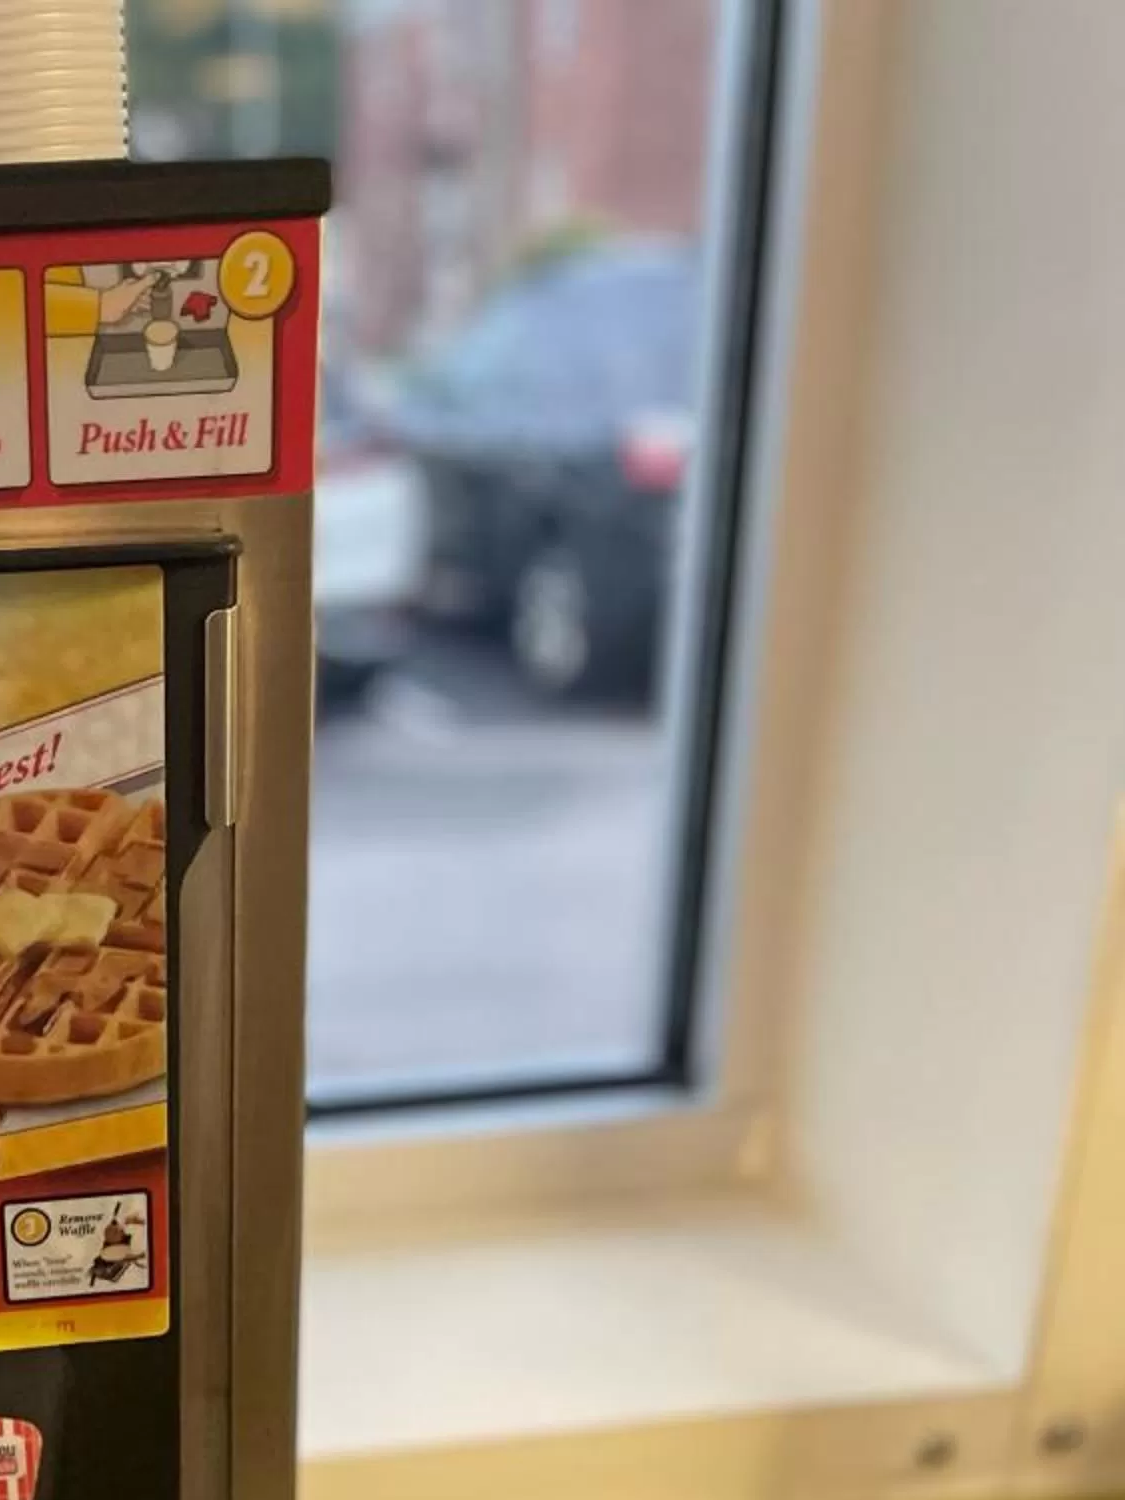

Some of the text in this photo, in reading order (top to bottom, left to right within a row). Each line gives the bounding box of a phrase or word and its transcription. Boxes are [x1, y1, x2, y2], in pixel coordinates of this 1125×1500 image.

[241, 250, 276, 299] 2
[77, 412, 251, 457] Push & Fill
[59, 1213, 104, 1225] Remove
[59, 1223, 96, 1237] Waffle
